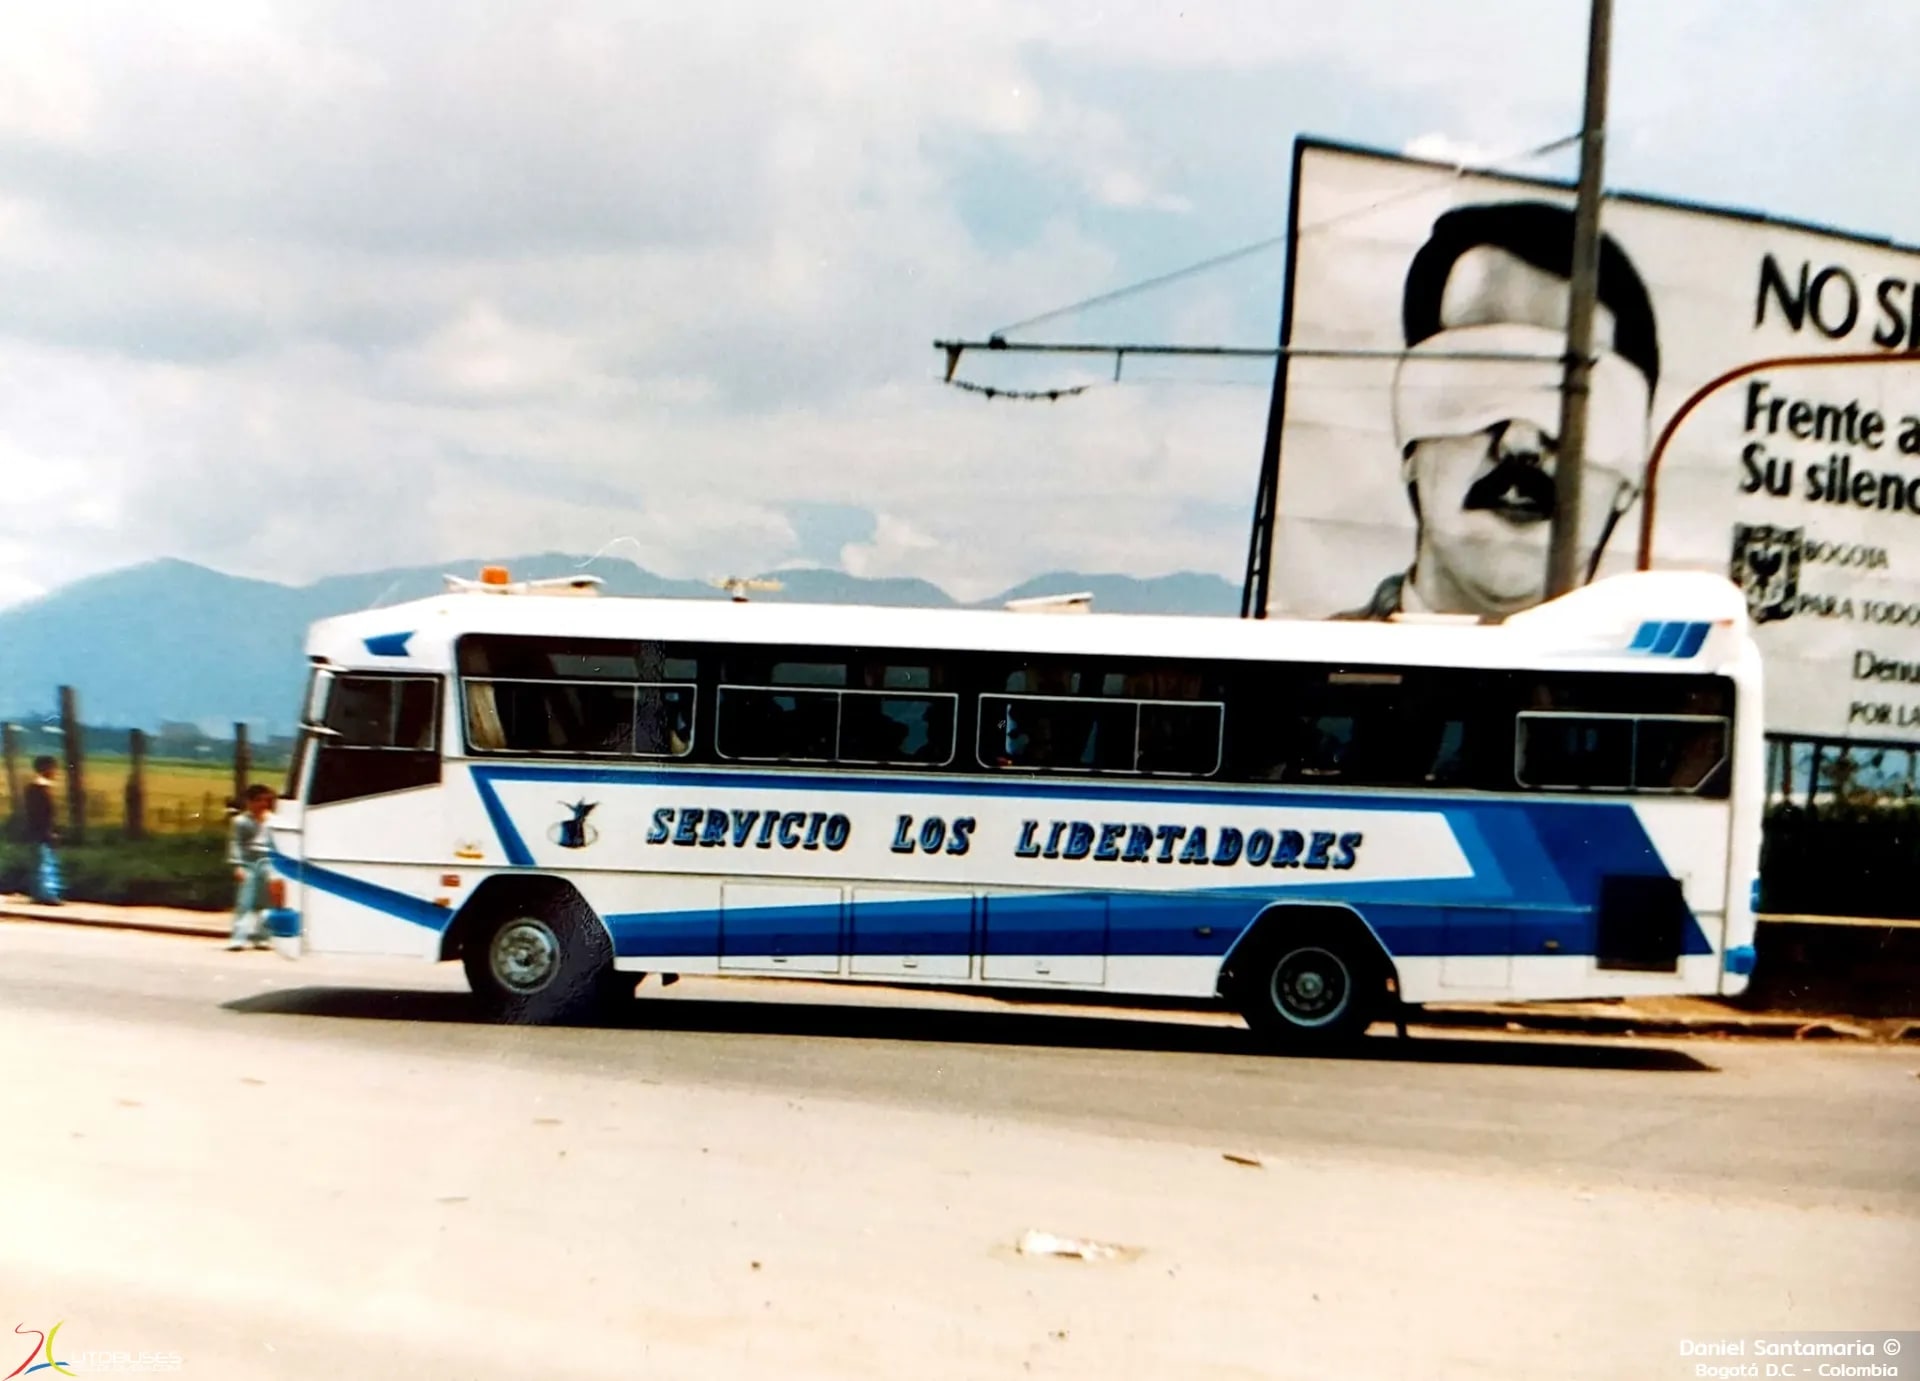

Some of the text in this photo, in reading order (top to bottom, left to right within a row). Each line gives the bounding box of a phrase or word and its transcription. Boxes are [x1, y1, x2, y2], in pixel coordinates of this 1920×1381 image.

[1755, 252, 1859, 339] NO
[1745, 381, 1885, 449] Frente
[1739, 442, 1793, 496] Su
[645, 806, 1363, 869] SERVICIO LOS LIBERTADORES
